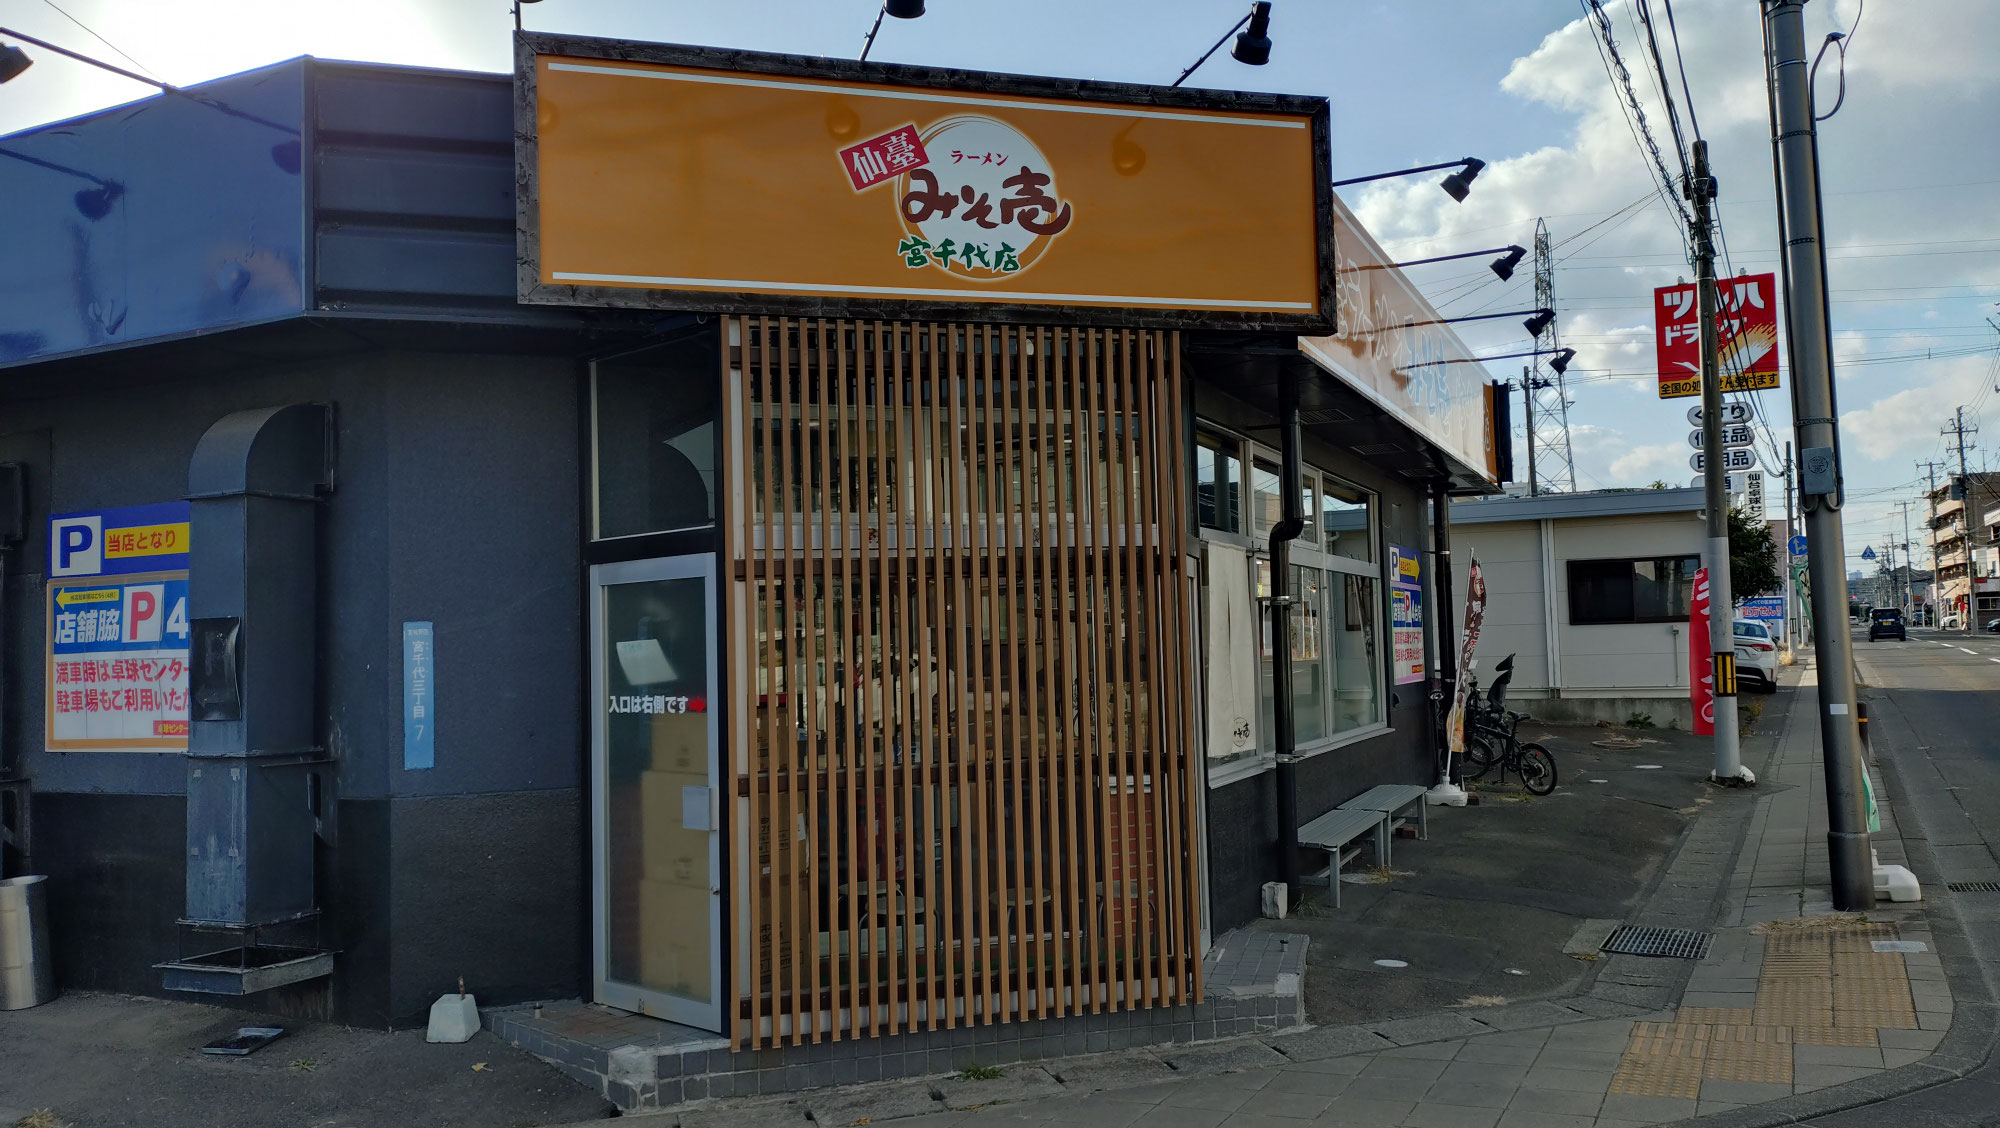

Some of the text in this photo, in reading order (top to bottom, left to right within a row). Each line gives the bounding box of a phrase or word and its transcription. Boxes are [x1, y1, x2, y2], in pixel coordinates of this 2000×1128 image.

[950, 150, 1009, 167] ラーメン
[902, 165, 1072, 236] みそ壱
[899, 236, 1020, 272] 宮千代店
[1664, 316, 1748, 347] ドラグ
[59, 525, 176, 569] P 当店となり
[54, 608, 120, 644] 店舗脇
[130, 591, 156, 640] P
[411, 640, 425, 741] 宮千代三丁目 7
[608, 695, 689, 714] 入口は右側です
